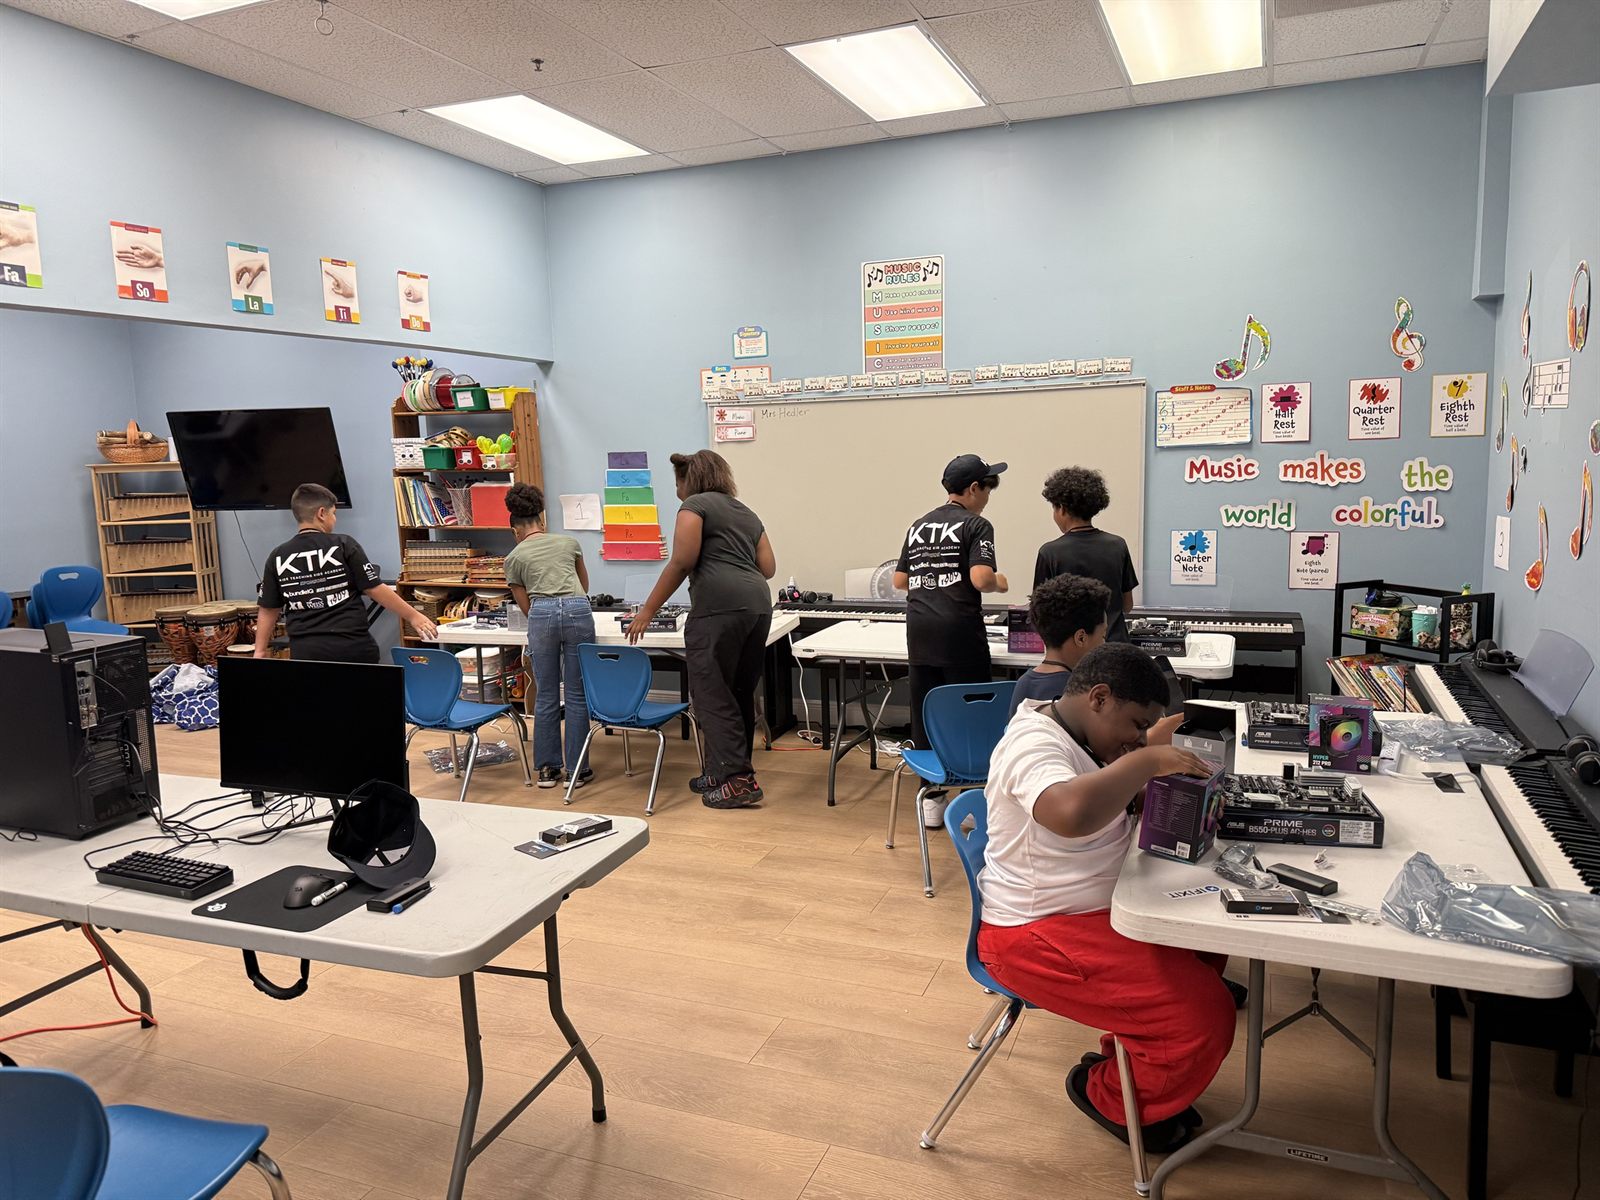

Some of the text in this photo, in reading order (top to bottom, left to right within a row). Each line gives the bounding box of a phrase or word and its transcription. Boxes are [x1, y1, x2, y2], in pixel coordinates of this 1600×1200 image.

[3, 265, 20, 282] Fa
[884, 262, 921, 274] MUSIC
[886, 273, 920, 284] RULES
[135, 283, 150, 298] So
[872, 291, 882, 303] M
[248, 296, 259, 311] La
[338, 306, 348, 321] Ti
[873, 307, 882, 318] U
[410, 316, 421, 328] Do
[908, 322, 939, 331] respect
[874, 324, 881, 335] S
[876, 342, 880, 353] I
[874, 358, 882, 368] C
[762, 407, 810, 419] Mrs Hedler
[1275, 408, 1294, 418] Half
[1353, 405, 1395, 416] Quarter
[1440, 400, 1475, 414] Eighth
[1362, 416, 1384, 426] Rest
[1445, 412, 1469, 423] Rest
[1274, 420, 1295, 430] Rest
[1188, 458, 1256, 480] Music
[1283, 454, 1362, 483] makes
[1405, 461, 1449, 488] the
[622, 493, 629, 501] Fa
[1224, 502, 1292, 528] world
[1335, 500, 1440, 527] colorful.
[908, 522, 964, 547] KTK
[276, 546, 343, 576] KTK
[1174, 554, 1212, 563] Quarter
[1182, 564, 1203, 572] Note
[1264, 819, 1303, 828] PRIME
[1249, 826, 1288, 834] B550-PLUS
[1290, 1149, 1326, 1161] LIFETIME
